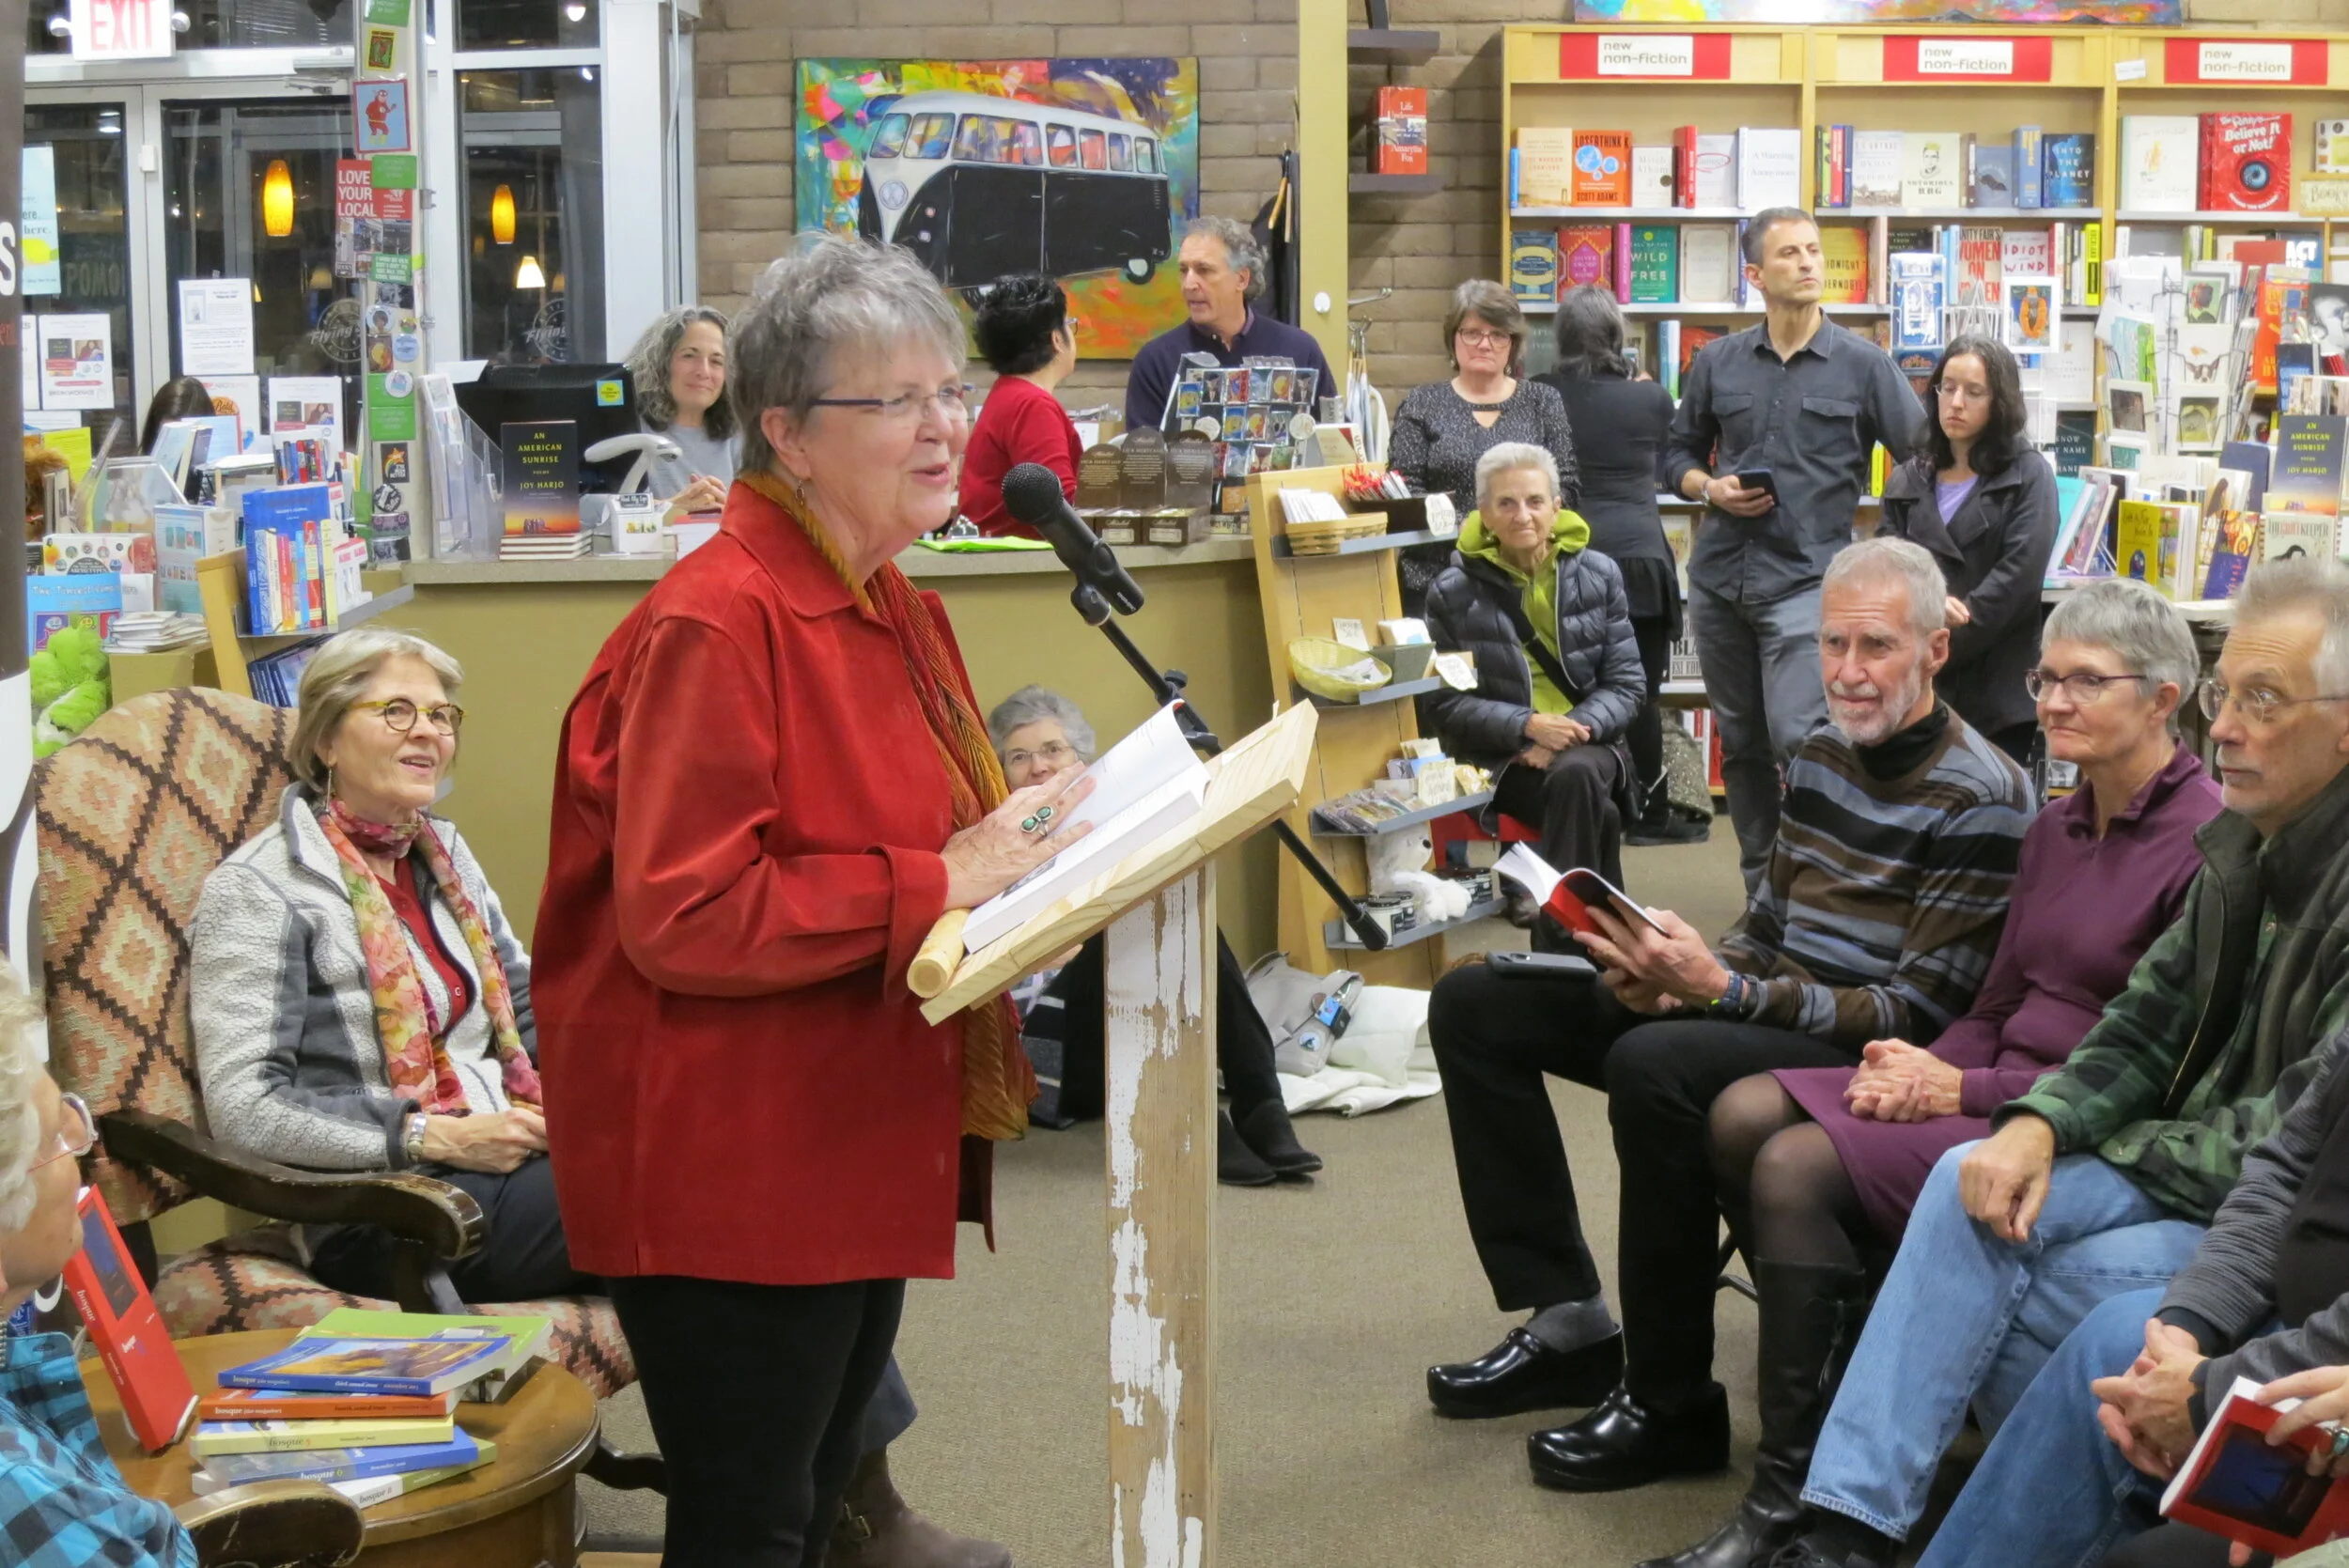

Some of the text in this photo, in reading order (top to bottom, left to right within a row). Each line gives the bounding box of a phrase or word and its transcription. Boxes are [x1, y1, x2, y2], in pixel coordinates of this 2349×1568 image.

[89, 0, 151, 51] EXIT
[1924, 48, 1952, 56] new
[2204, 50, 2232, 58] new
[1603, 54, 1688, 64] non-fiction
[1924, 58, 2007, 70] non-fiction
[2203, 60, 2286, 73] non-fiction
[2225, 121, 2280, 142] Believe It
[1575, 135, 1621, 148] LOSERTHINK
[2233, 138, 2274, 154] or Not!
[338, 170, 371, 184] LOVE
[2047, 170, 2091, 179] PLANET
[338, 187, 373, 200] YOUR
[1577, 192, 1618, 201] SCOTT ADAMS
[338, 202, 378, 217] LOCAL
[2004, 244, 2046, 256] IDIOT
[2286, 241, 2317, 261] ACT
[1631, 252, 1668, 261] WILD
[1969, 262, 1984, 281] ON
[2004, 263, 2045, 272] WIND
[1631, 271, 1667, 281] FREE
[2290, 433, 2330, 442] AMERICAN
[518, 443, 562, 452] AMERICAN
[2293, 443, 2326, 452] SUNRISE
[522, 456, 559, 464] SUNRISE
[2303, 467, 2327, 475] HARJO
[520, 481, 564, 490] JOY HARJO
[2301, 521, 2329, 536] KEEPER
[77, 1289, 96, 1322] bosque
[233, 1374, 257, 1385] bosque
[214, 1406, 243, 1416] bosque
[269, 1437, 303, 1448] bosque
[300, 1469, 334, 1481] bosque
[336, 1467, 343, 1477] 6
[359, 1490, 386, 1504] bosque
